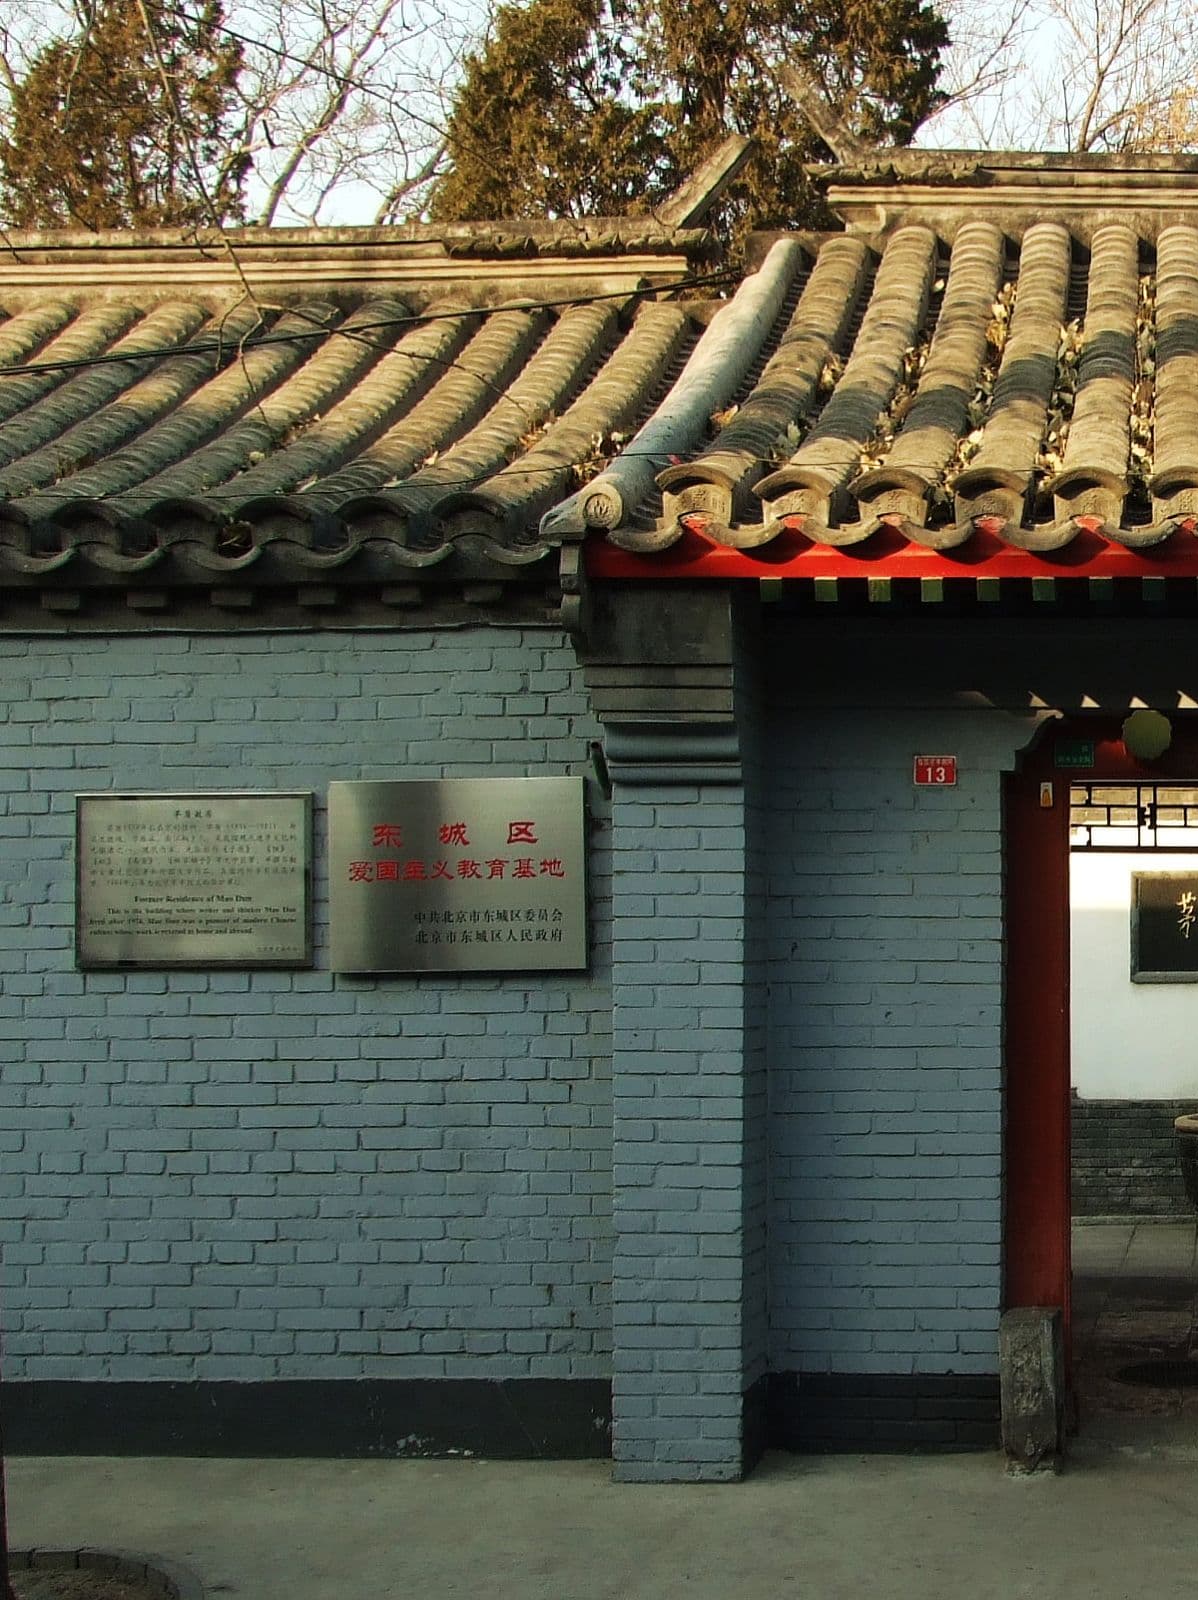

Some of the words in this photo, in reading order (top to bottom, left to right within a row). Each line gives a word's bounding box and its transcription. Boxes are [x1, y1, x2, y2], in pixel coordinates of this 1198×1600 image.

[926, 767, 945, 782] 13
[372, 821, 539, 848] 东城区
[348, 858, 566, 882] 爱国主义教育基地
[414, 907, 564, 923] 中共北京市东城区委员会
[414, 928, 563, 944] 北京市东城区人民政府
